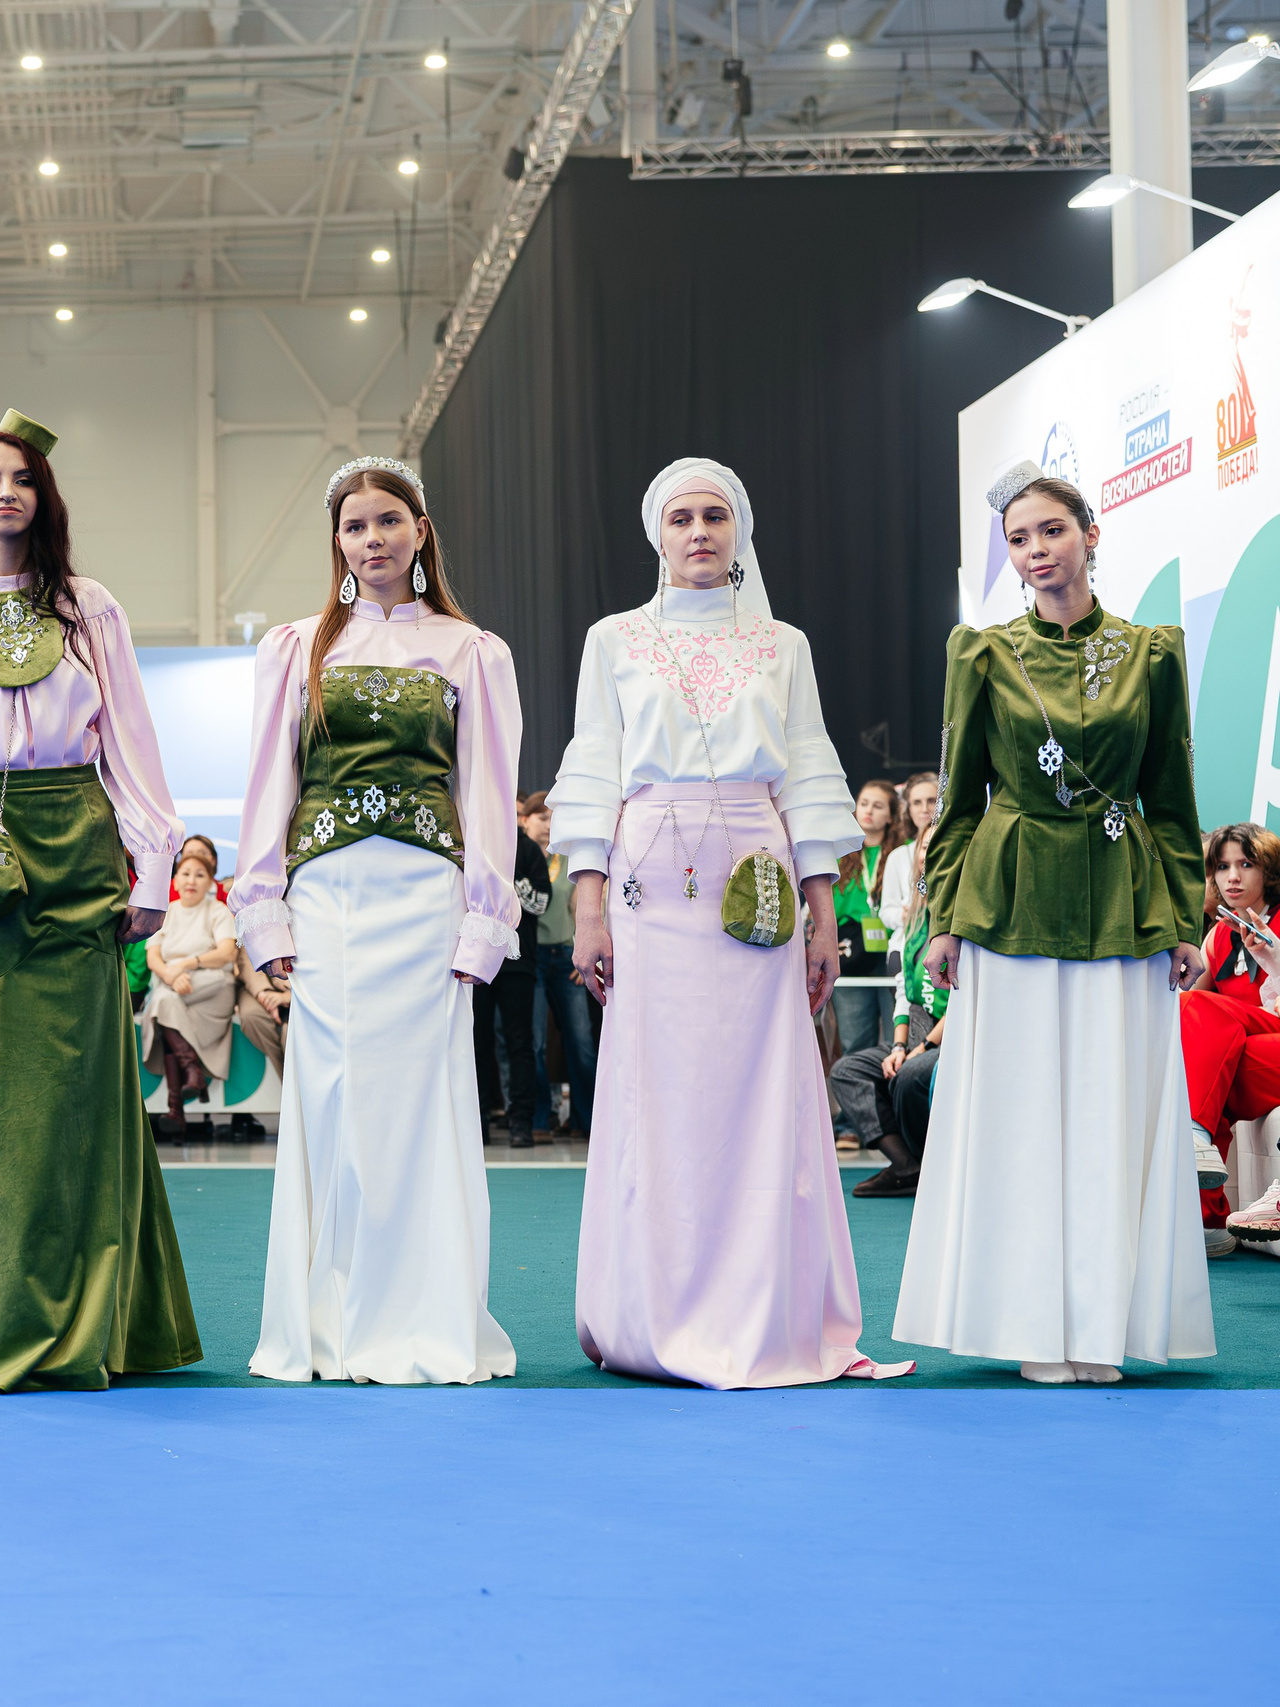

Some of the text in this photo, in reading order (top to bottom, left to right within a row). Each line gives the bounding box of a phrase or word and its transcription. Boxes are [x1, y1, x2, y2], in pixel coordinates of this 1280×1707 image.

[1119, 384, 1160, 427] РОССИЯ
[1216, 392, 1238, 453] 80
[1126, 418, 1167, 462] СТРАНА
[1102, 439, 1189, 511] ВОЗМОЖНОСТЕЙ
[1217, 446, 1259, 491] ПОБЕДА!
